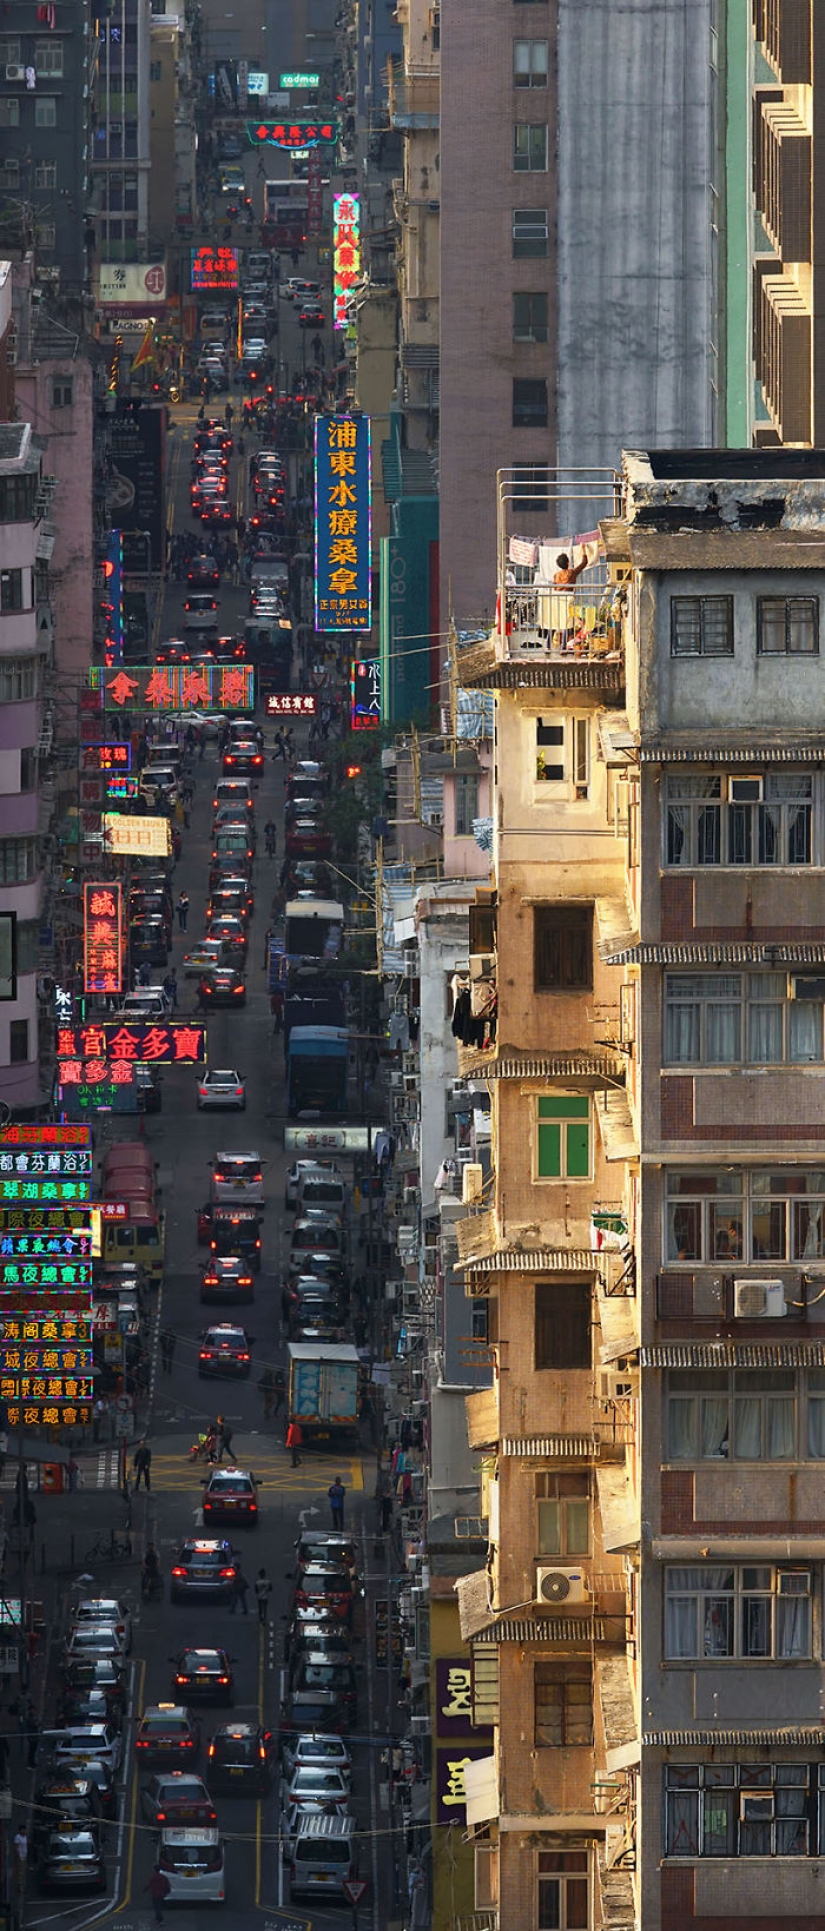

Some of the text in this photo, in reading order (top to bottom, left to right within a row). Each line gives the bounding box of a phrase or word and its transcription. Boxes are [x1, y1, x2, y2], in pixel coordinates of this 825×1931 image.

[327, 420, 358, 595] 浦東水療桑拿
[368, 663, 381, 710] 水上人
[108, 1027, 202, 1061] 金多寶
[0, 1154, 77, 1171] 都會芬蘭浴
[3, 1181, 77, 1199] 翠湖桑拿
[3, 1266, 77, 1283] 馬夜總會
